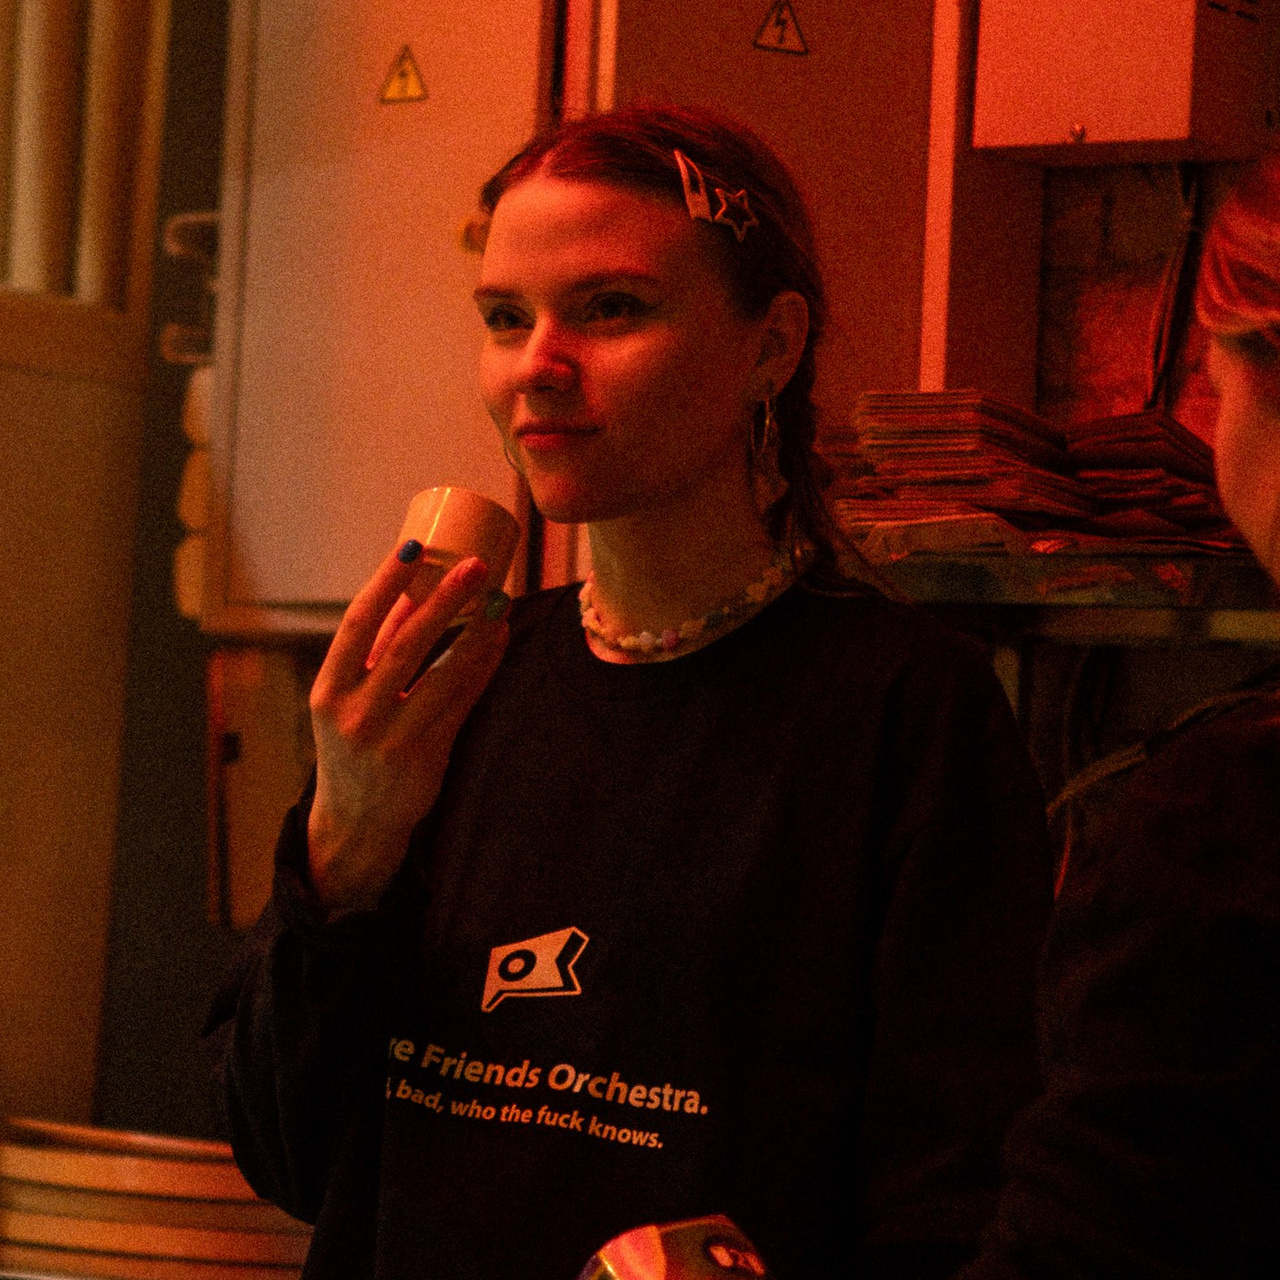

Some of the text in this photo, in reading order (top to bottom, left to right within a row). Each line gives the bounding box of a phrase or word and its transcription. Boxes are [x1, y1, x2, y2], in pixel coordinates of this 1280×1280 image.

[395, 1079, 444, 1113] bad,
[450, 1098, 496, 1120] who
[500, 1103, 533, 1124] the
[535, 1104, 585, 1132] fuck
[587, 1115, 664, 1149] knows.
[421, 1043, 542, 1089] Friends
[547, 1063, 709, 1115] Orchestra.
